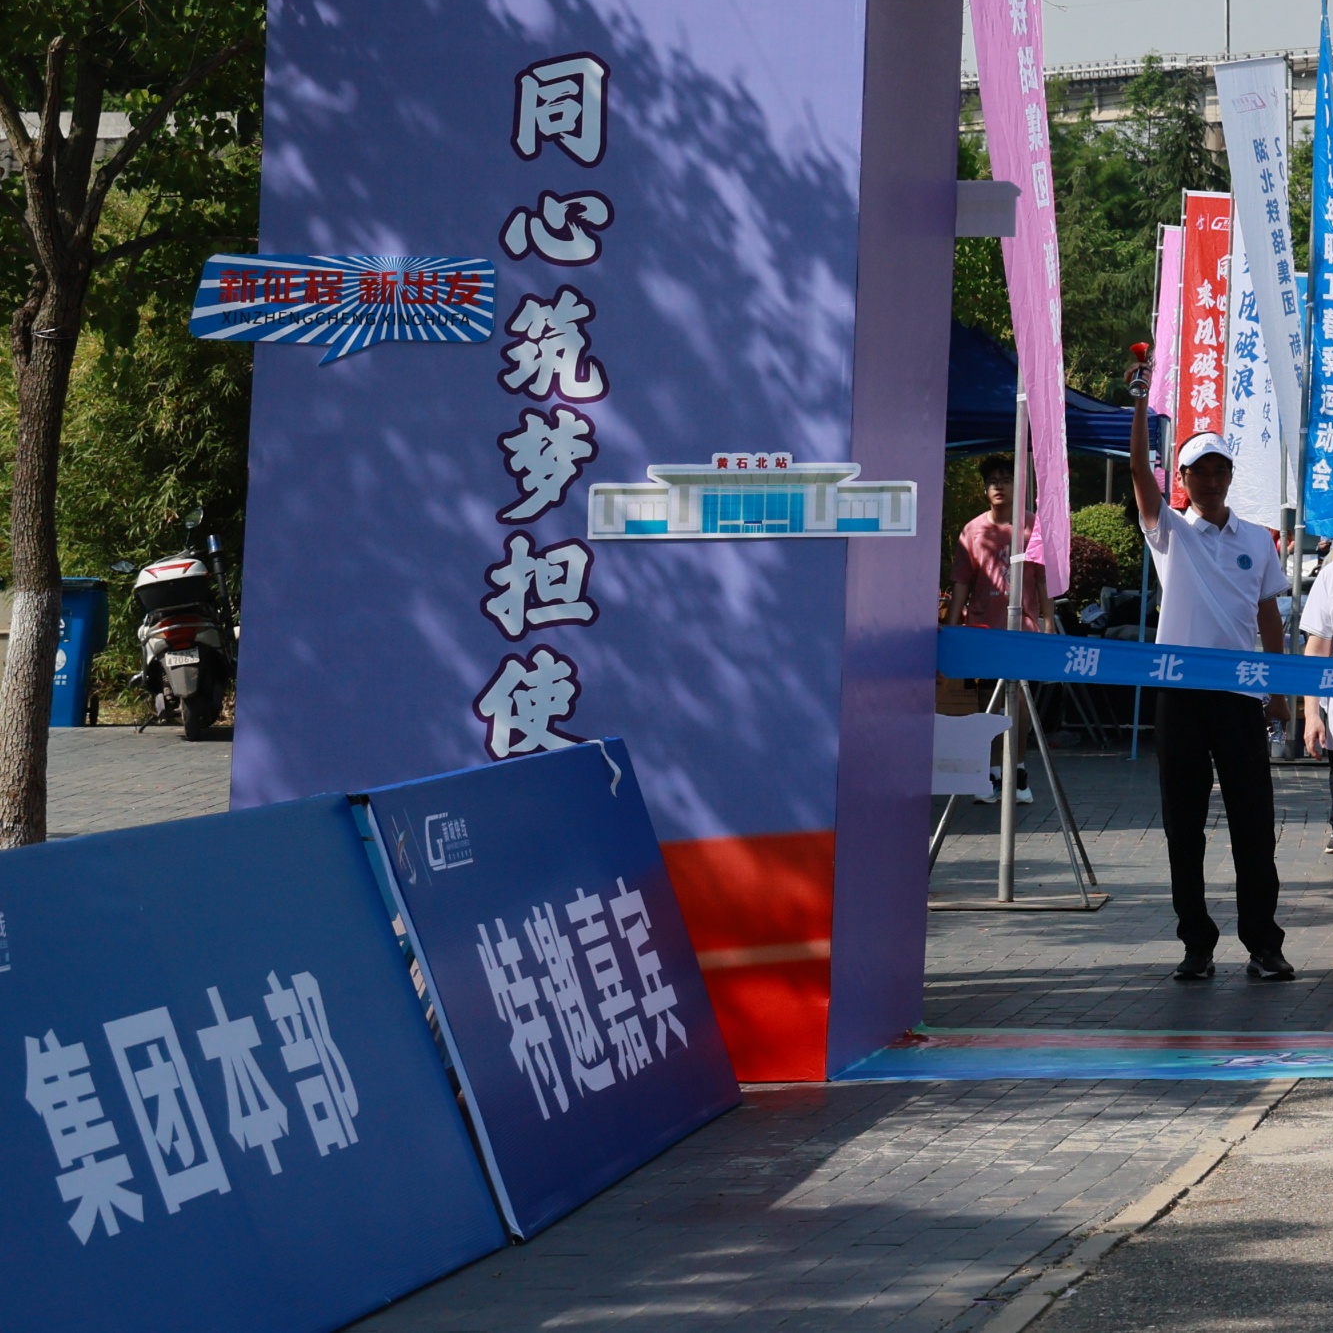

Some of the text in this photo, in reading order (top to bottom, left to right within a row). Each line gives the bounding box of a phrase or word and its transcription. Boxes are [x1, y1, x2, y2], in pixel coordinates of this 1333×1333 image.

[219, 269, 482, 306] 新征程 新出发
[222, 310, 470, 327] XINZHENGCHENG XINCHUFA
[717, 456, 788, 469] 黄石北站
[478, 876, 688, 1121] 特邀嘉宾
[24, 970, 359, 1247] 集团本部
